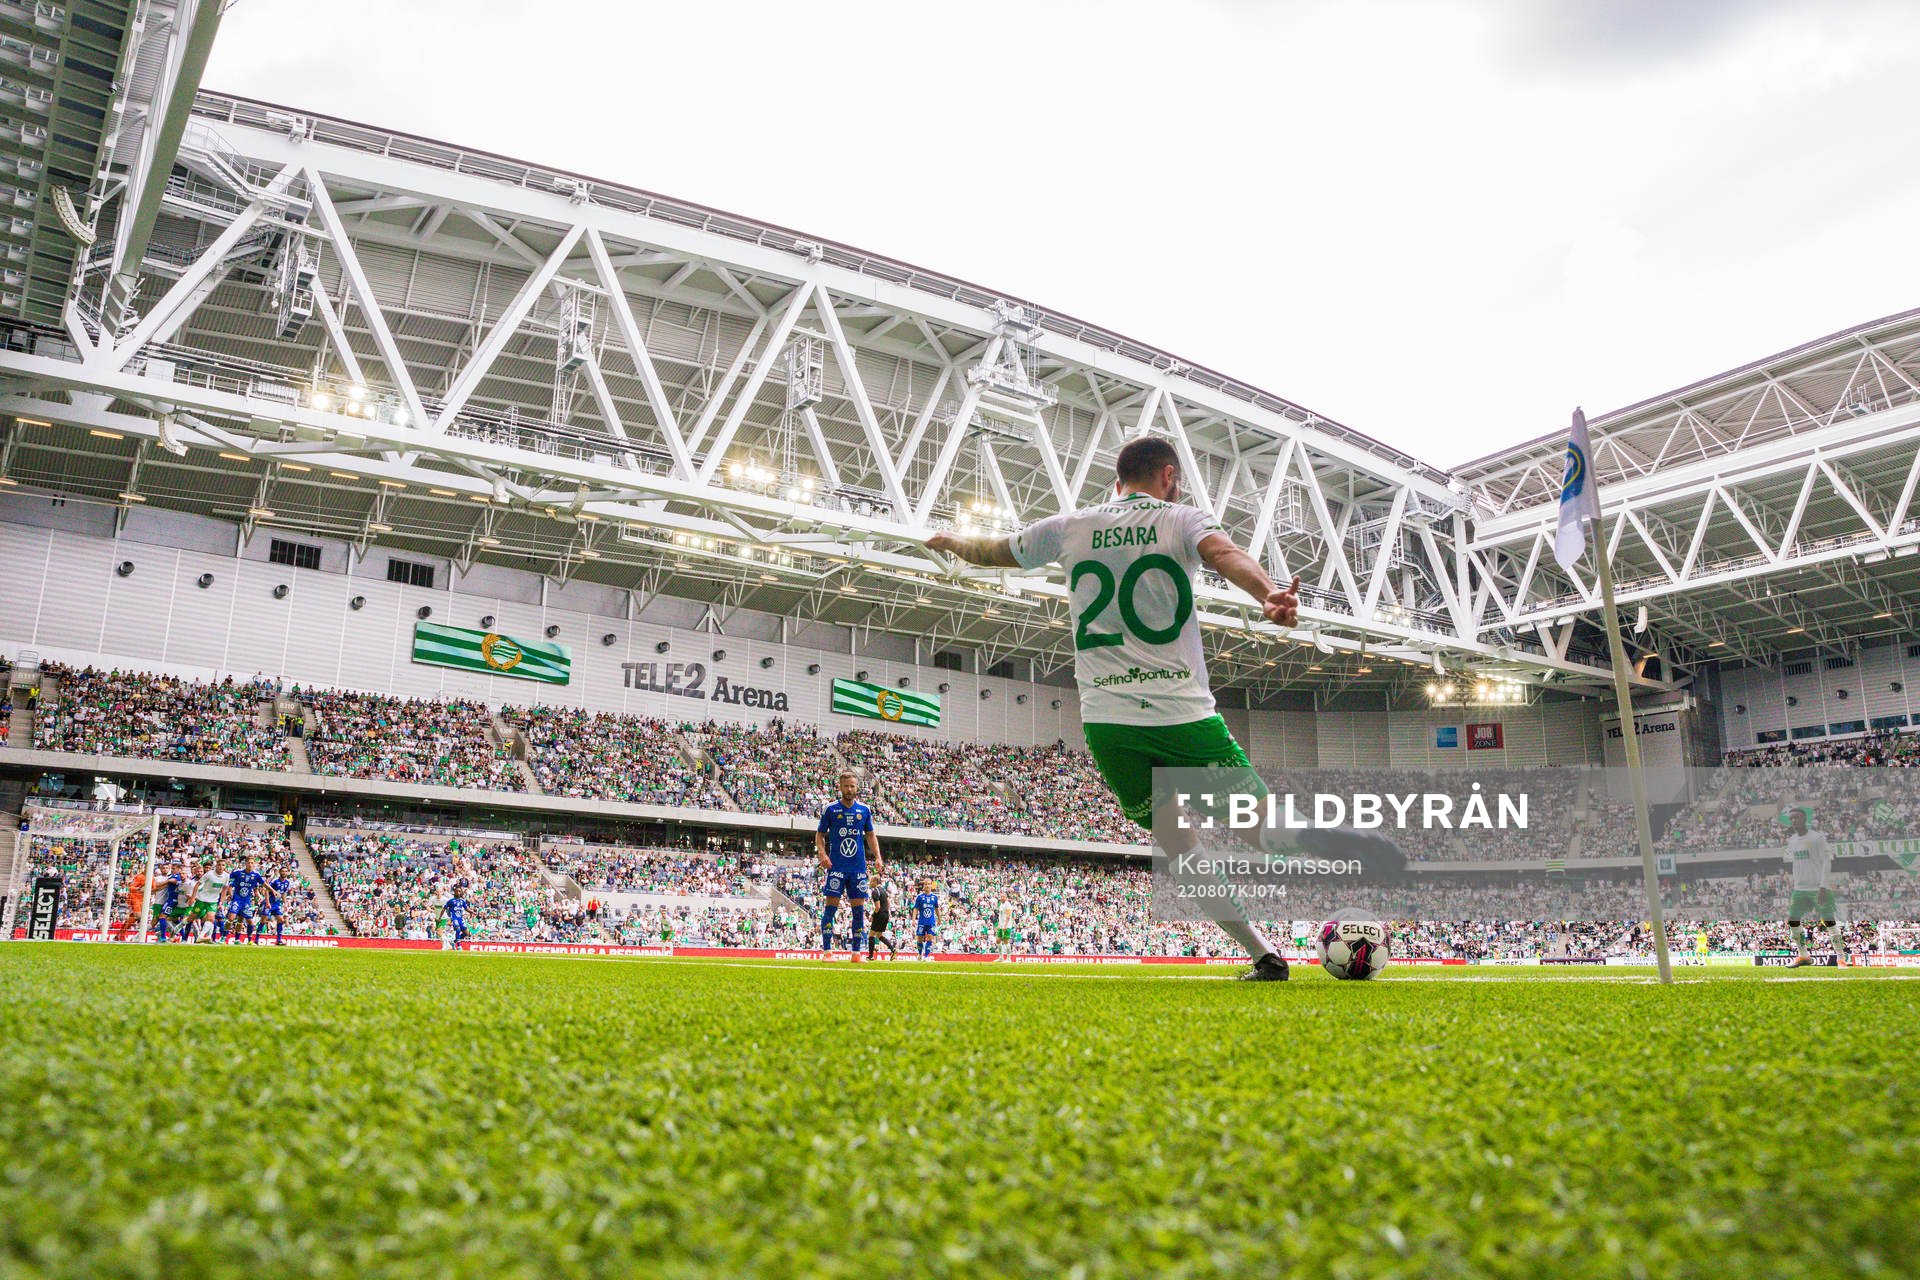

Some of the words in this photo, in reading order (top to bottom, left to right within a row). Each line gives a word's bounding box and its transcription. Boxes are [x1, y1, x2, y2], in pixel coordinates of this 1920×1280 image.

[1092, 526, 1158, 549] BESARA
[1071, 553, 1193, 651] 20
[621, 662, 706, 699] TELE2
[711, 676, 789, 712] Arena
[1093, 674, 1132, 687] Sefina
[1607, 722, 1640, 738] TEL2
[1642, 722, 1675, 735] Arena
[1474, 739, 1498, 748] ZONE
[33, 887, 56, 941] SELECT
[1342, 924, 1381, 938] SELECT
[470, 944, 515, 953] EVERY
[518, 945, 568, 954] LEGEND
[570, 947, 596, 955] HAS
[609, 948, 673, 957] BEGINNING
[775, 952, 812, 960] EVERY
